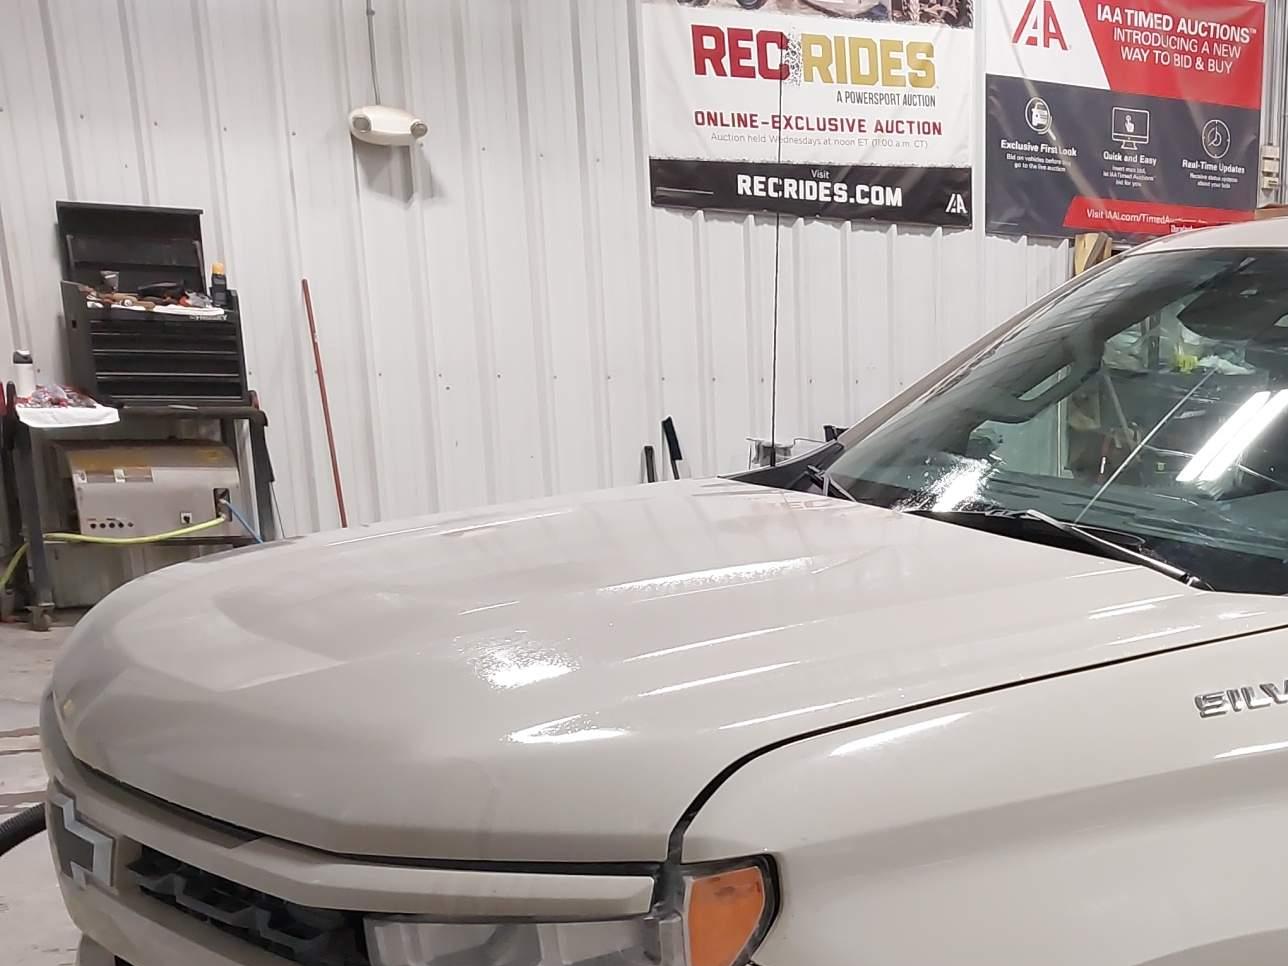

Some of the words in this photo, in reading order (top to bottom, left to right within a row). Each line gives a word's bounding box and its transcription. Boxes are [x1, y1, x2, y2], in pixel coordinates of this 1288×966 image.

[1097, 4, 1123, 25] IAA
[1125, 9, 1173, 31] TIMED
[1114, 27, 1198, 51] INTRODUCING
[1201, 41, 1210, 54] A
[1213, 42, 1242, 59] NEW
[691, 24, 790, 81] REC
[801, 33, 937, 89] RIDES
[1121, 46, 1150, 63] WAY
[1153, 50, 1170, 65] TO
[1174, 53, 1192, 69] BID
[1195, 56, 1205, 71] &
[1208, 57, 1233, 74] BUY
[836, 91, 843, 104] A
[845, 91, 900, 105] POWERSPORT
[902, 93, 936, 107] AUCTION
[694, 110, 867, 133] ONLINE-EXCLUSIVE
[874, 119, 943, 136] AUCTION
[711, 132, 745, 142] Auction
[823, 138, 830, 146] at
[858, 138, 868, 146] ET
[1000, 139, 1039, 152] Exclusive
[1040, 143, 1057, 154] First
[1103, 151, 1122, 161] Quick
[1124, 154, 1137, 163] and
[1140, 155, 1157, 167] Easy
[1182, 159, 1218, 171] Real-Time
[1219, 162, 1245, 174] Updates
[811, 169, 829, 179] Visit
[737, 174, 902, 207] RECRIDES.COM
[1086, 208, 1104, 219] Visit
